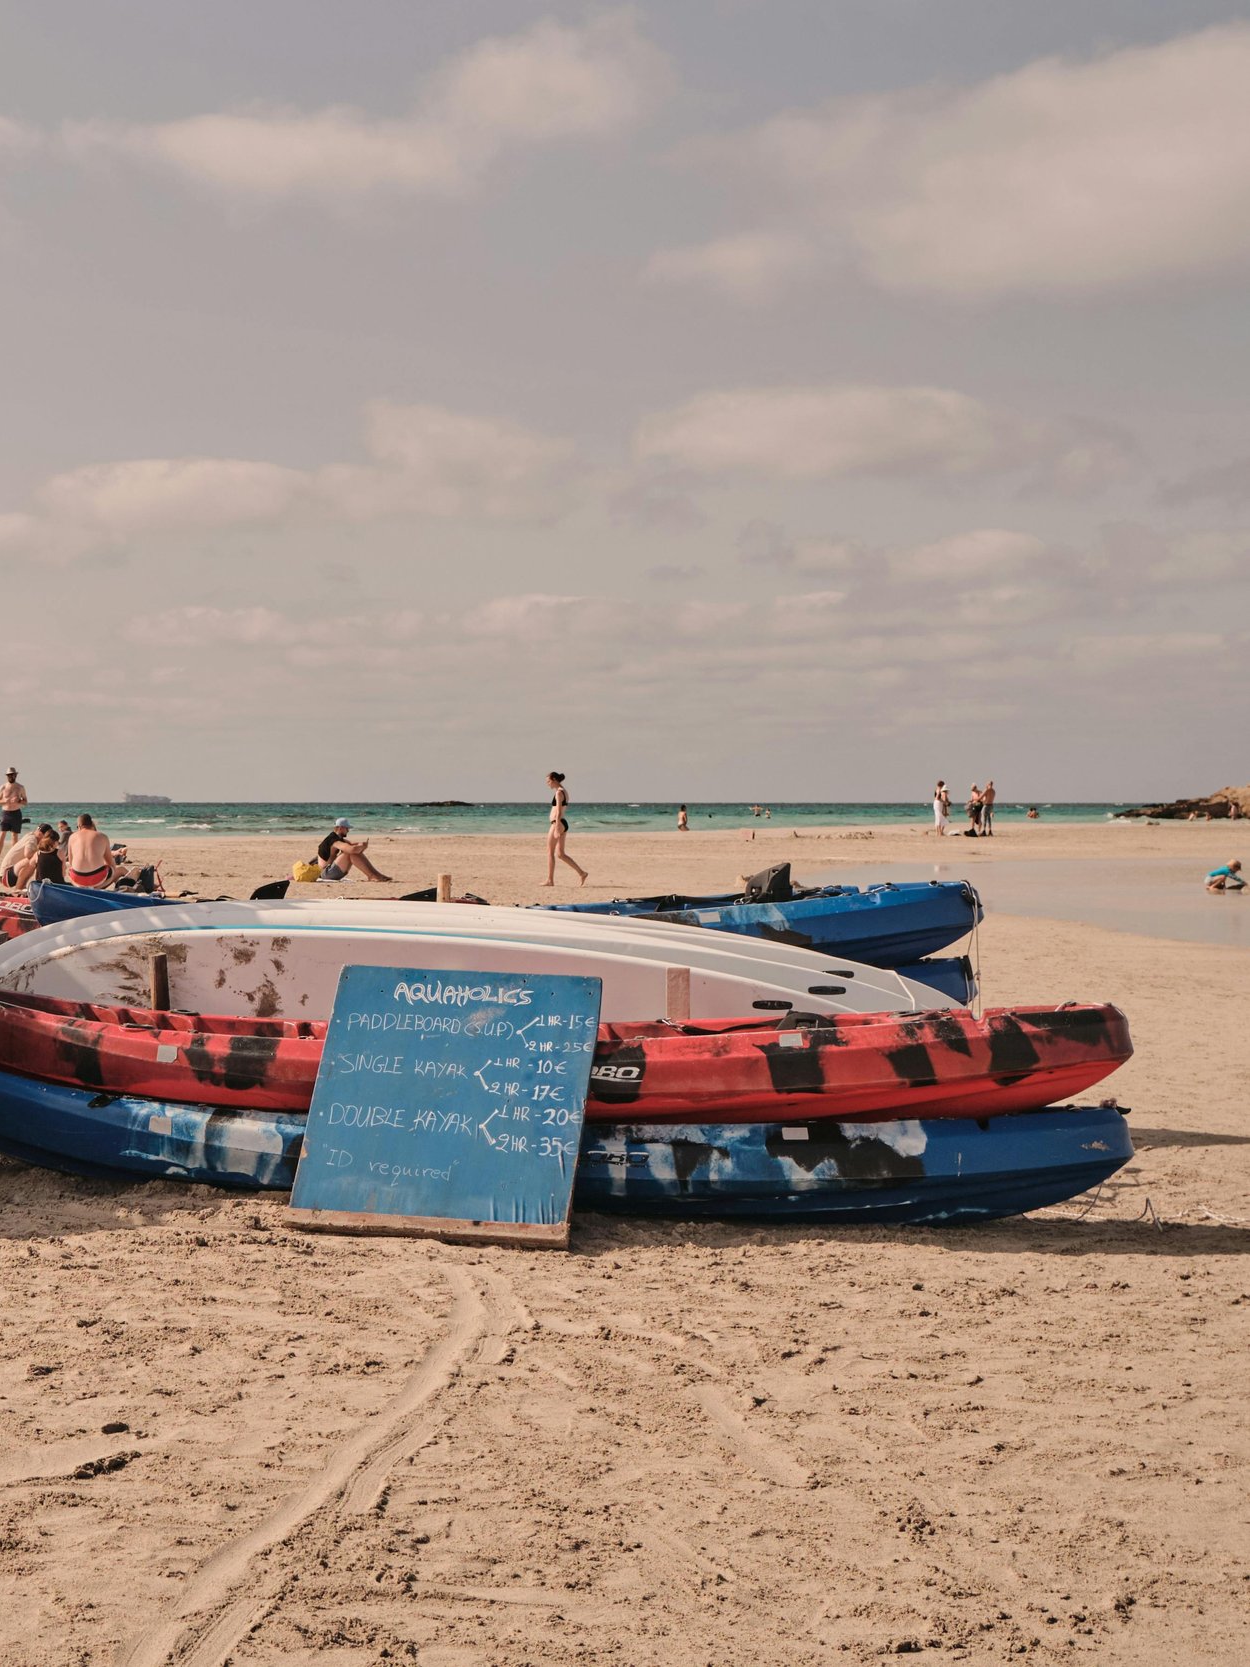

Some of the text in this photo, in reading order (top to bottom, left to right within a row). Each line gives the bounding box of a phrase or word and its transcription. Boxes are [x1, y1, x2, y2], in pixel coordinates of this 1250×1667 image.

[393, 980, 535, 1008] AQUAHOLICS
[347, 1012, 462, 1035] PADDLEBOARD
[535, 1014, 546, 1027] 1
[528, 1041, 537, 1052] 2
[339, 1053, 468, 1079] SINGLE KAYAK
[493, 1057, 504, 1067] 1
[505, 1057, 520, 1070] HR
[591, 1065, 641, 1079] BO
[488, 1081, 502, 1096] 2
[327, 1102, 473, 1136] DOUBLE KAYAK
[498, 1104, 510, 1118] 1
[512, 1106, 530, 1121] HR
[495, 1133, 510, 1153] 2
